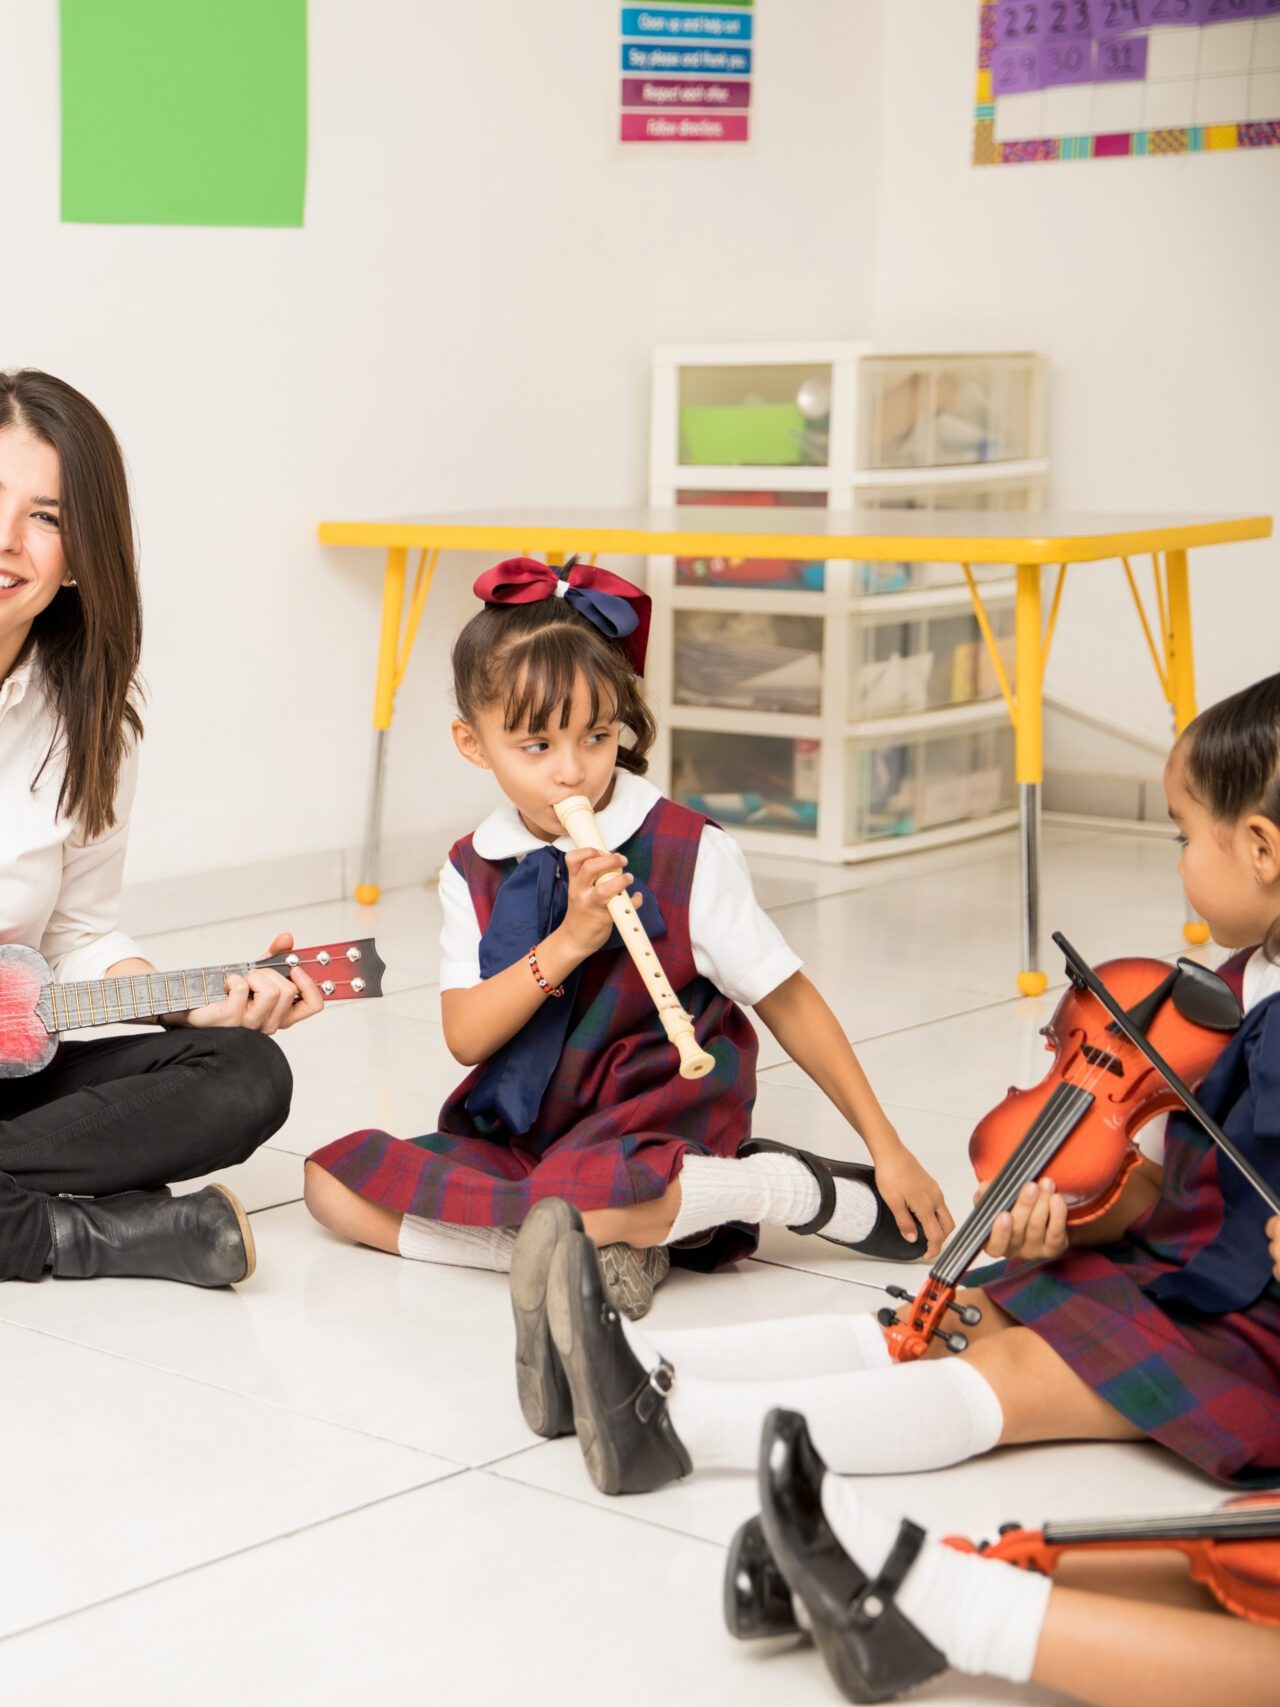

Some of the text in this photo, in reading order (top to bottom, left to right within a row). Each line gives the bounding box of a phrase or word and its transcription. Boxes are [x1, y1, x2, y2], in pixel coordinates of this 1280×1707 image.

[1003, 3, 1039, 37] 22
[1049, 0, 1089, 33] 23
[1104, 0, 1140, 28] 24
[998, 43, 1137, 87] 29 30 31
